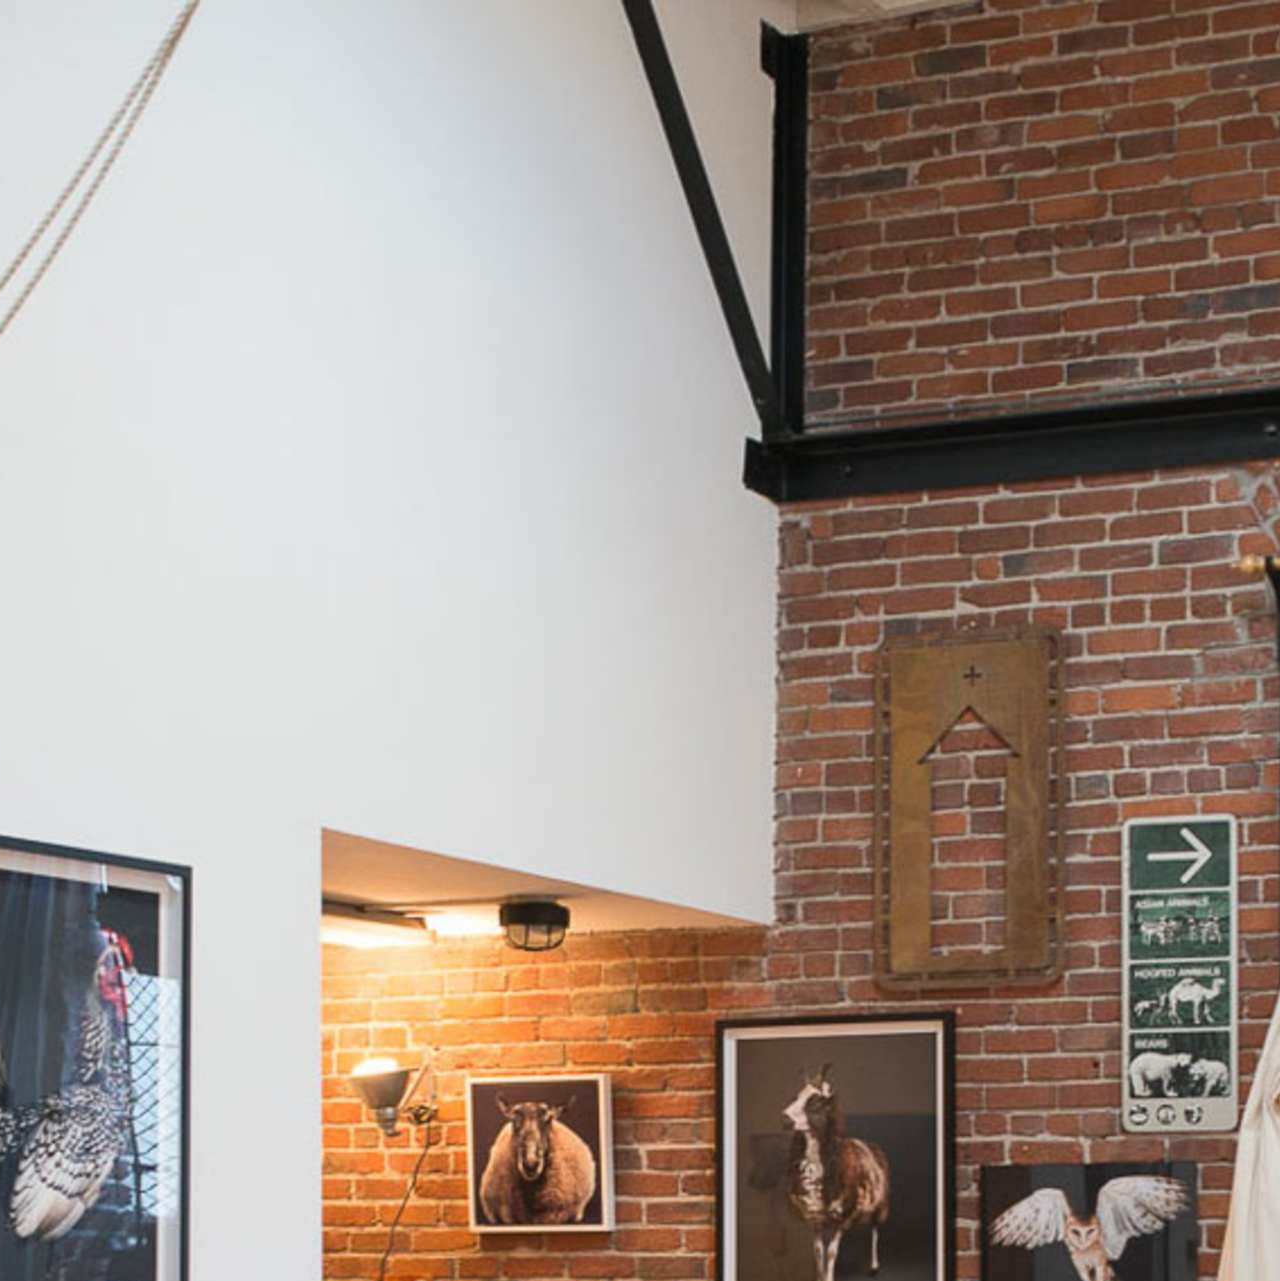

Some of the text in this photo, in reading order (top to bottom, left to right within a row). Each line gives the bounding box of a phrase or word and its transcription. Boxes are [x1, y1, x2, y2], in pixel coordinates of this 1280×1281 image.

[1167, 896, 1210, 907] ANIMALS
[1134, 966, 1221, 978] HOOFED ANIMALS
